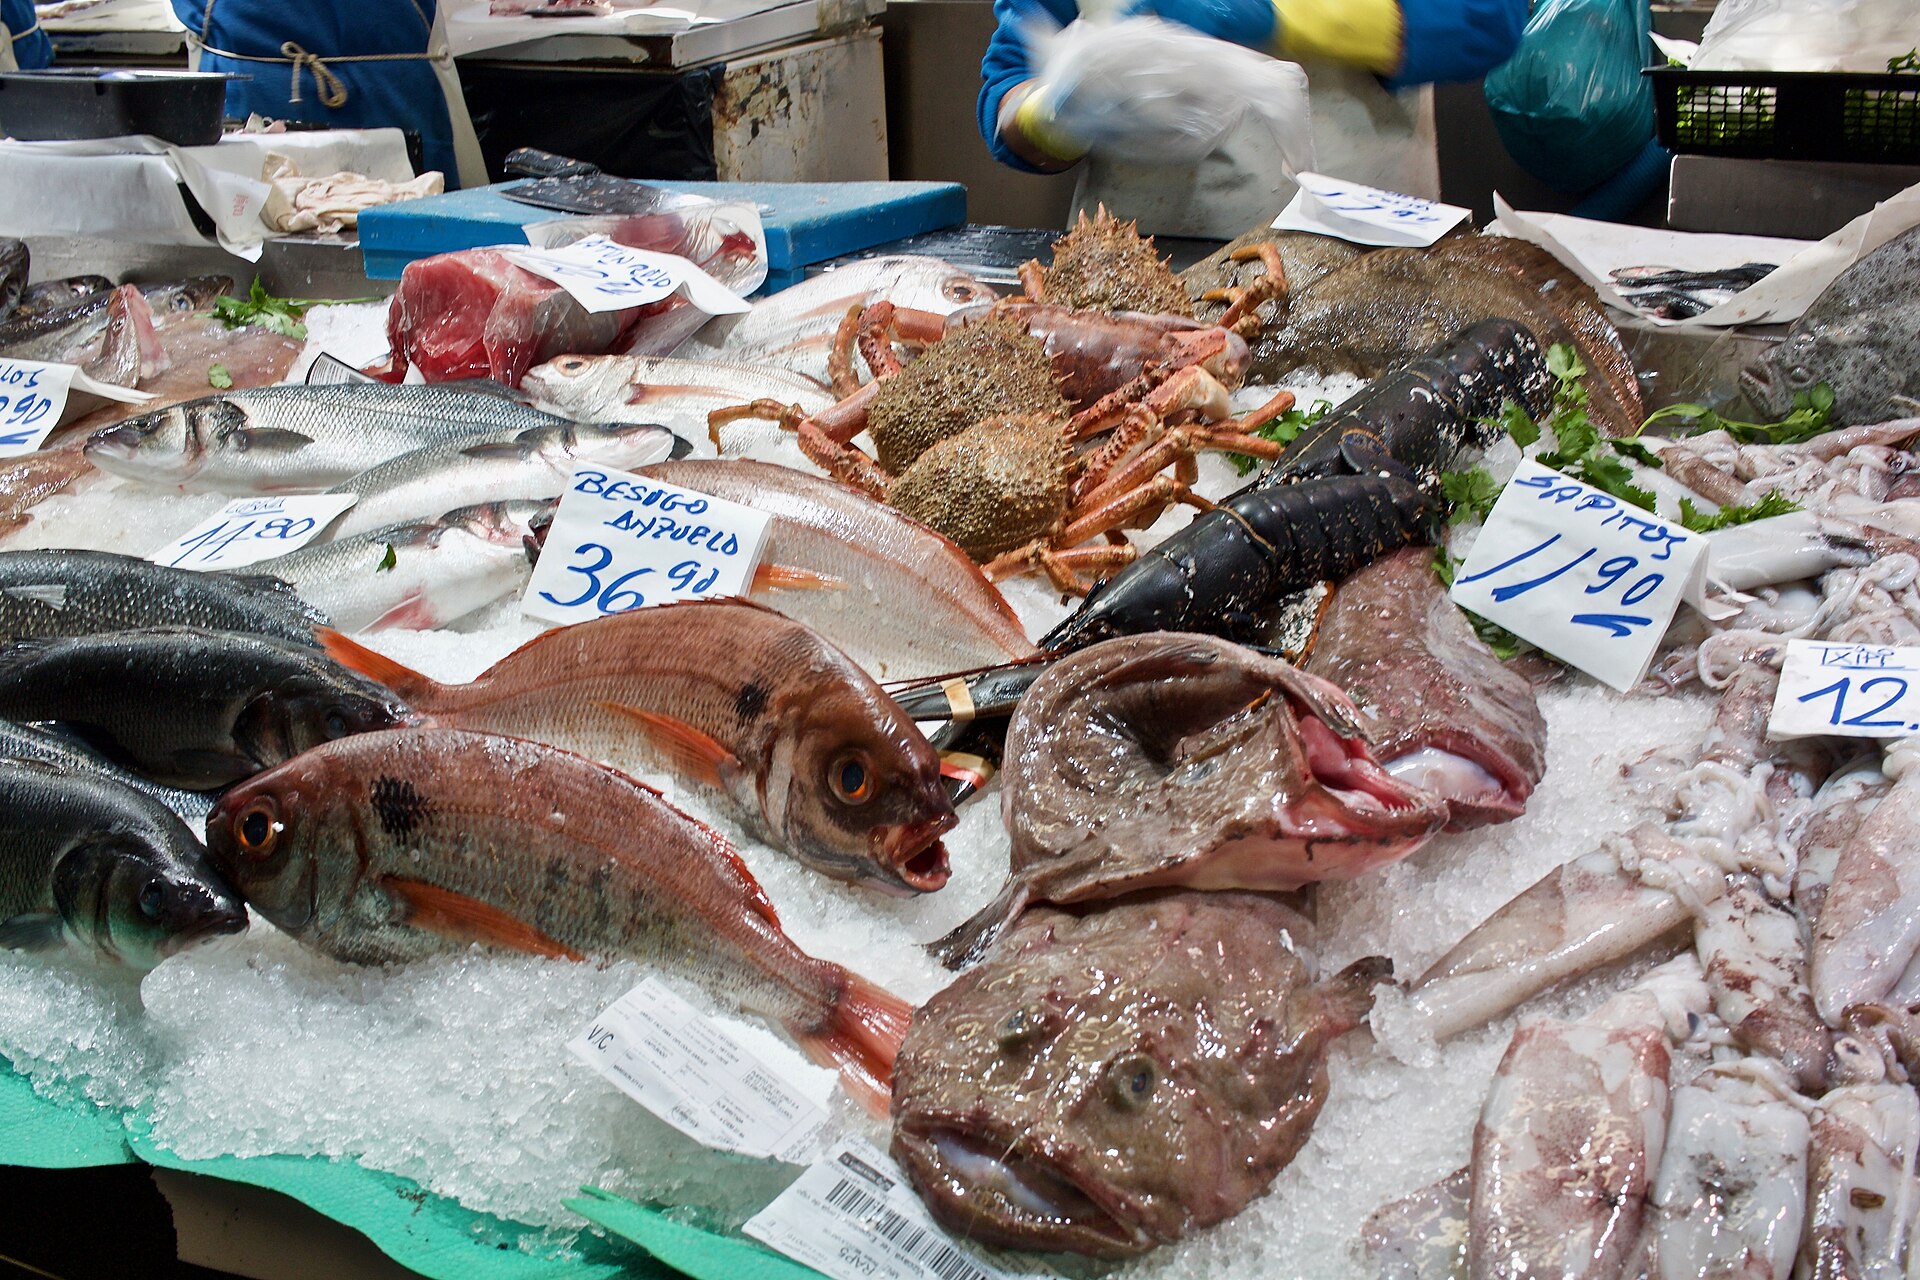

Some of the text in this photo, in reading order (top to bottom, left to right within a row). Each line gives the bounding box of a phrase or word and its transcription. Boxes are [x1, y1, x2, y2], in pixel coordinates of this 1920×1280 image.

[574, 471, 709, 515] BESUGO
[1514, 476, 1687, 560] SAPITOS
[603, 509, 739, 556] ANZUELO
[539, 543, 656, 614] 36
